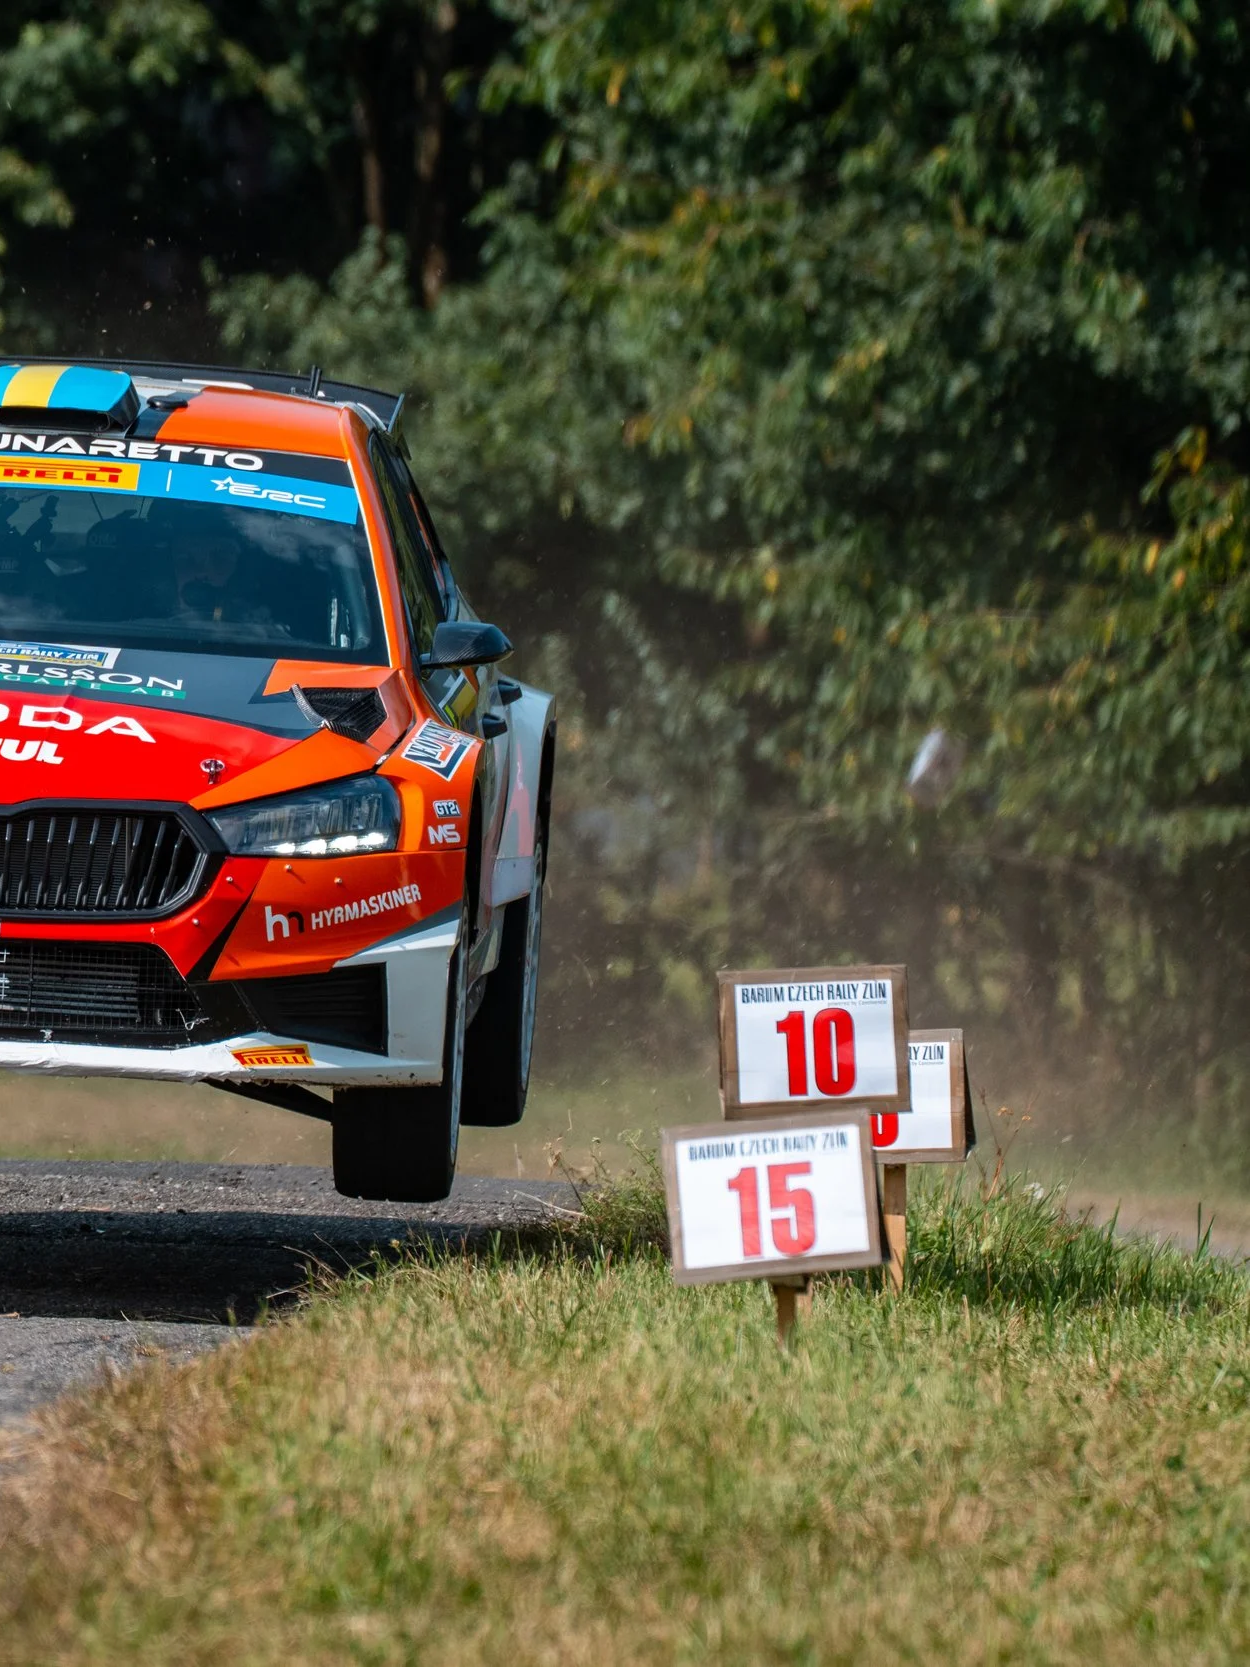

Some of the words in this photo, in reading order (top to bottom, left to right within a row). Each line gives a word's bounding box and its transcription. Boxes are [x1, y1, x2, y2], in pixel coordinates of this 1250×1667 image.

[131, 687, 175, 697] AB
[428, 823, 461, 844] MS
[311, 883, 422, 931] HYRMASKINER
[741, 986, 784, 1004] BARUM
[788, 984, 824, 1002] CZECH
[827, 982, 859, 1000] RALLY
[233, 1047, 310, 1066] PIRELLI
[776, 1007, 857, 1097] 10
[727, 1161, 817, 1259] 15
